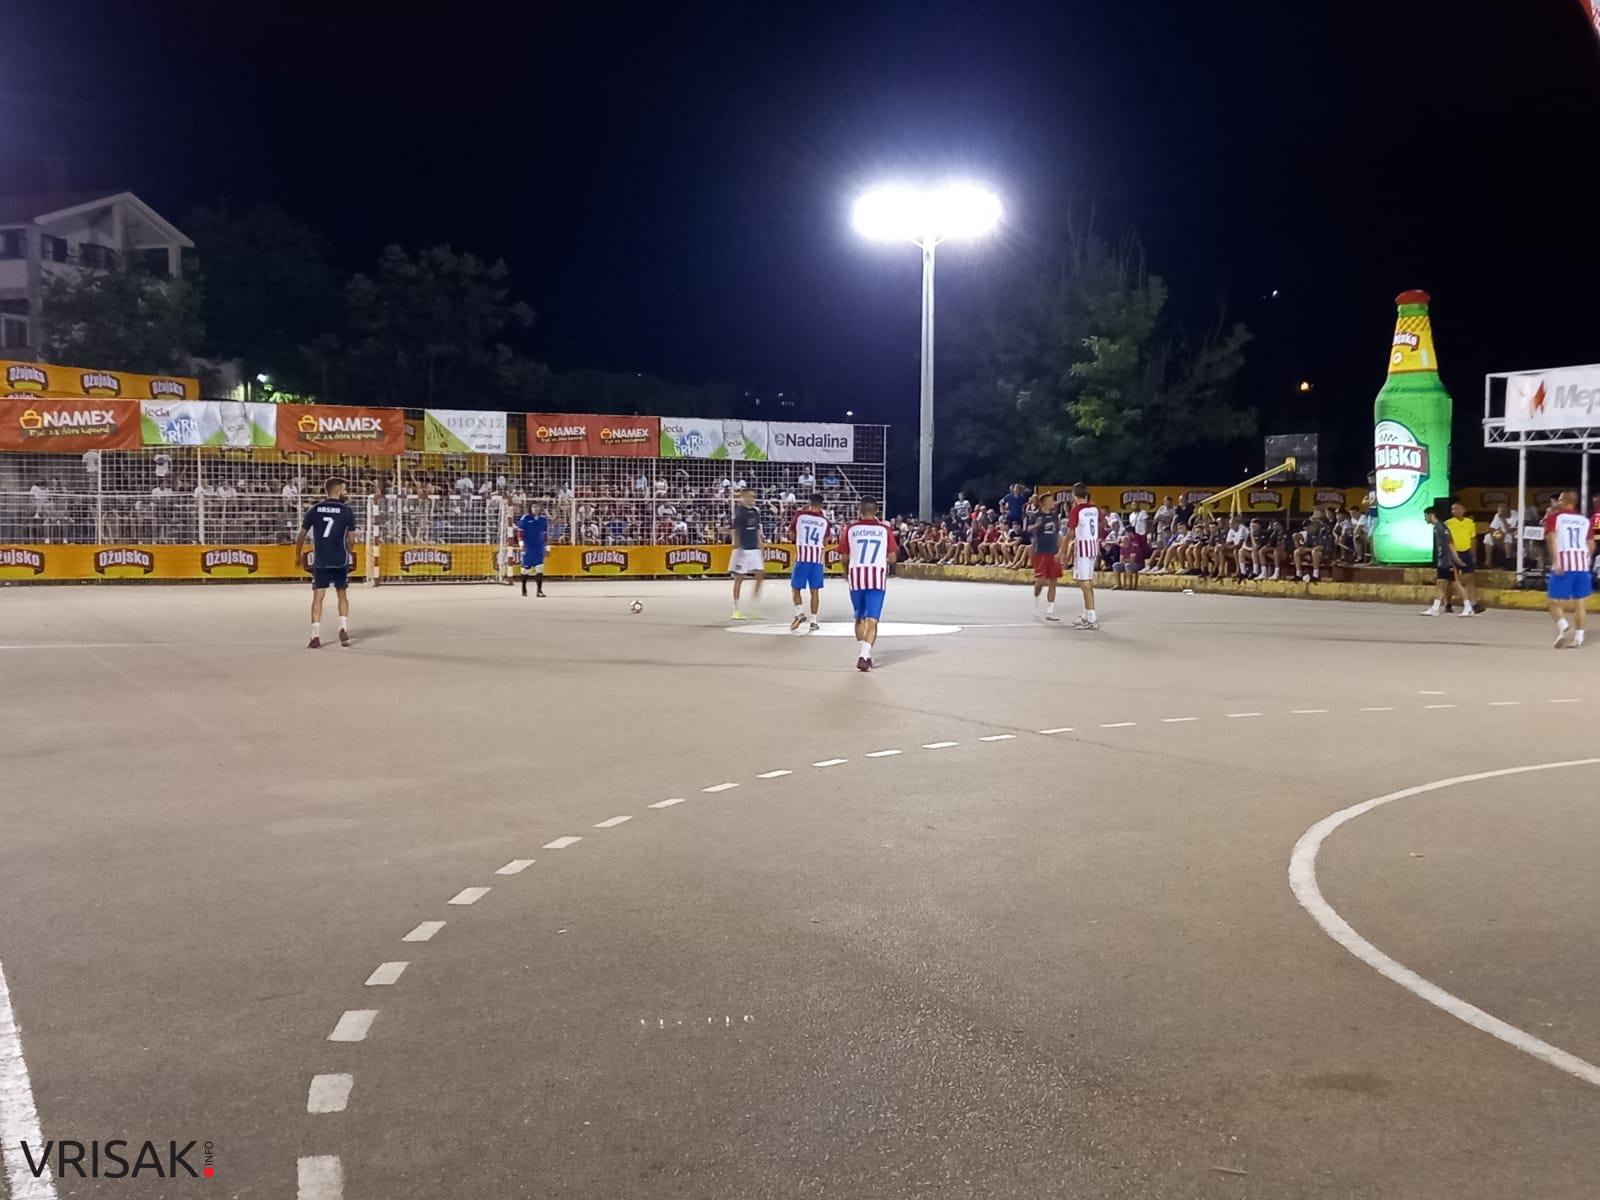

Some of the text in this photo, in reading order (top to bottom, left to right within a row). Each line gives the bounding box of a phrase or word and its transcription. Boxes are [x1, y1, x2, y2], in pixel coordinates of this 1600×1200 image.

[43, 410, 116, 427] NAMEX
[319, 417, 383, 432] NAMEX
[447, 417, 504, 428] DIONIZ
[548, 427, 586, 437] NAMEX
[613, 429, 648, 439] NAMEX
[786, 433, 848, 448] Nadalina
[322, 516, 335, 538] 7
[1089, 518, 1096, 536] 6
[804, 526, 820, 545] 14
[99, 549, 150, 567] Ožujsko
[205, 550, 254, 566] Ožujsko
[585, 550, 625, 565] Ožujsko
[669, 549, 708, 564] Ožujsko
[857, 539, 881, 564] 77
